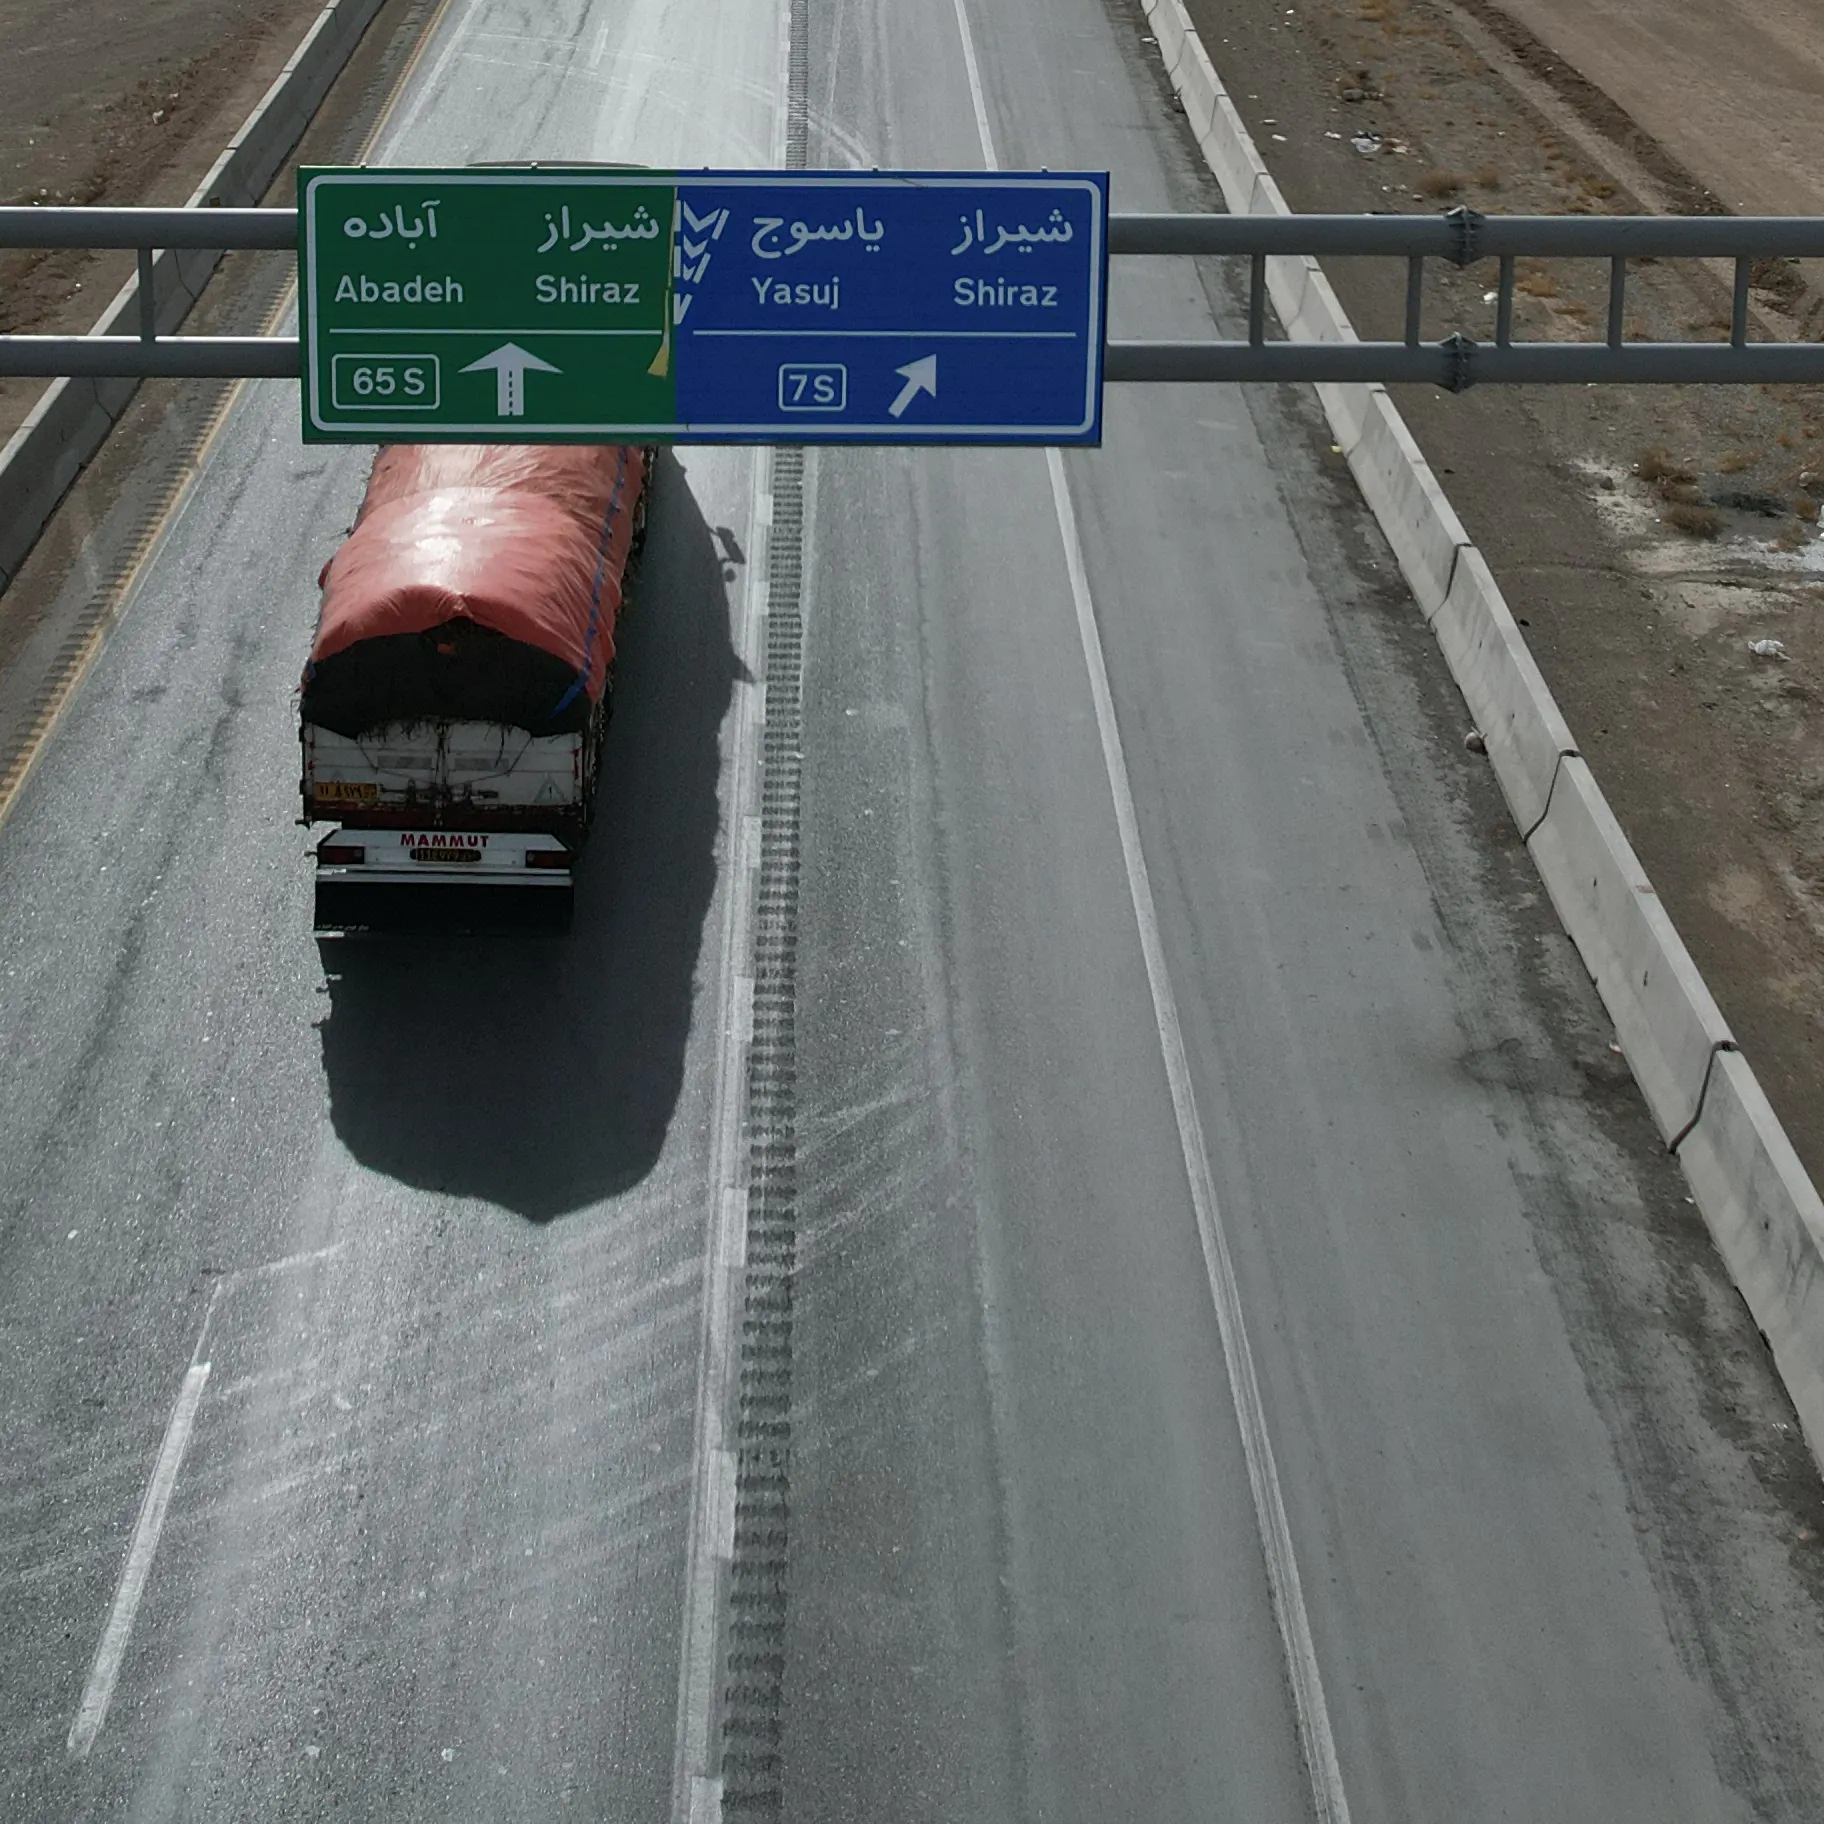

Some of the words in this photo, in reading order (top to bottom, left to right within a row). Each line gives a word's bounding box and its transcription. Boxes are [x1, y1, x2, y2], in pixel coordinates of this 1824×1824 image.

[343, 198, 440, 249] آباده
[537, 205, 659, 253] شیراز
[751, 207, 884, 259] یاسوج
[951, 209, 1073, 255] شیراز
[334, 275, 463, 303] Abadeh
[535, 275, 640, 303] Shiraz
[751, 277, 839, 309] Yasuj
[953, 277, 1057, 306] Shiraz
[400, 833, 489, 847] MAMMUT
